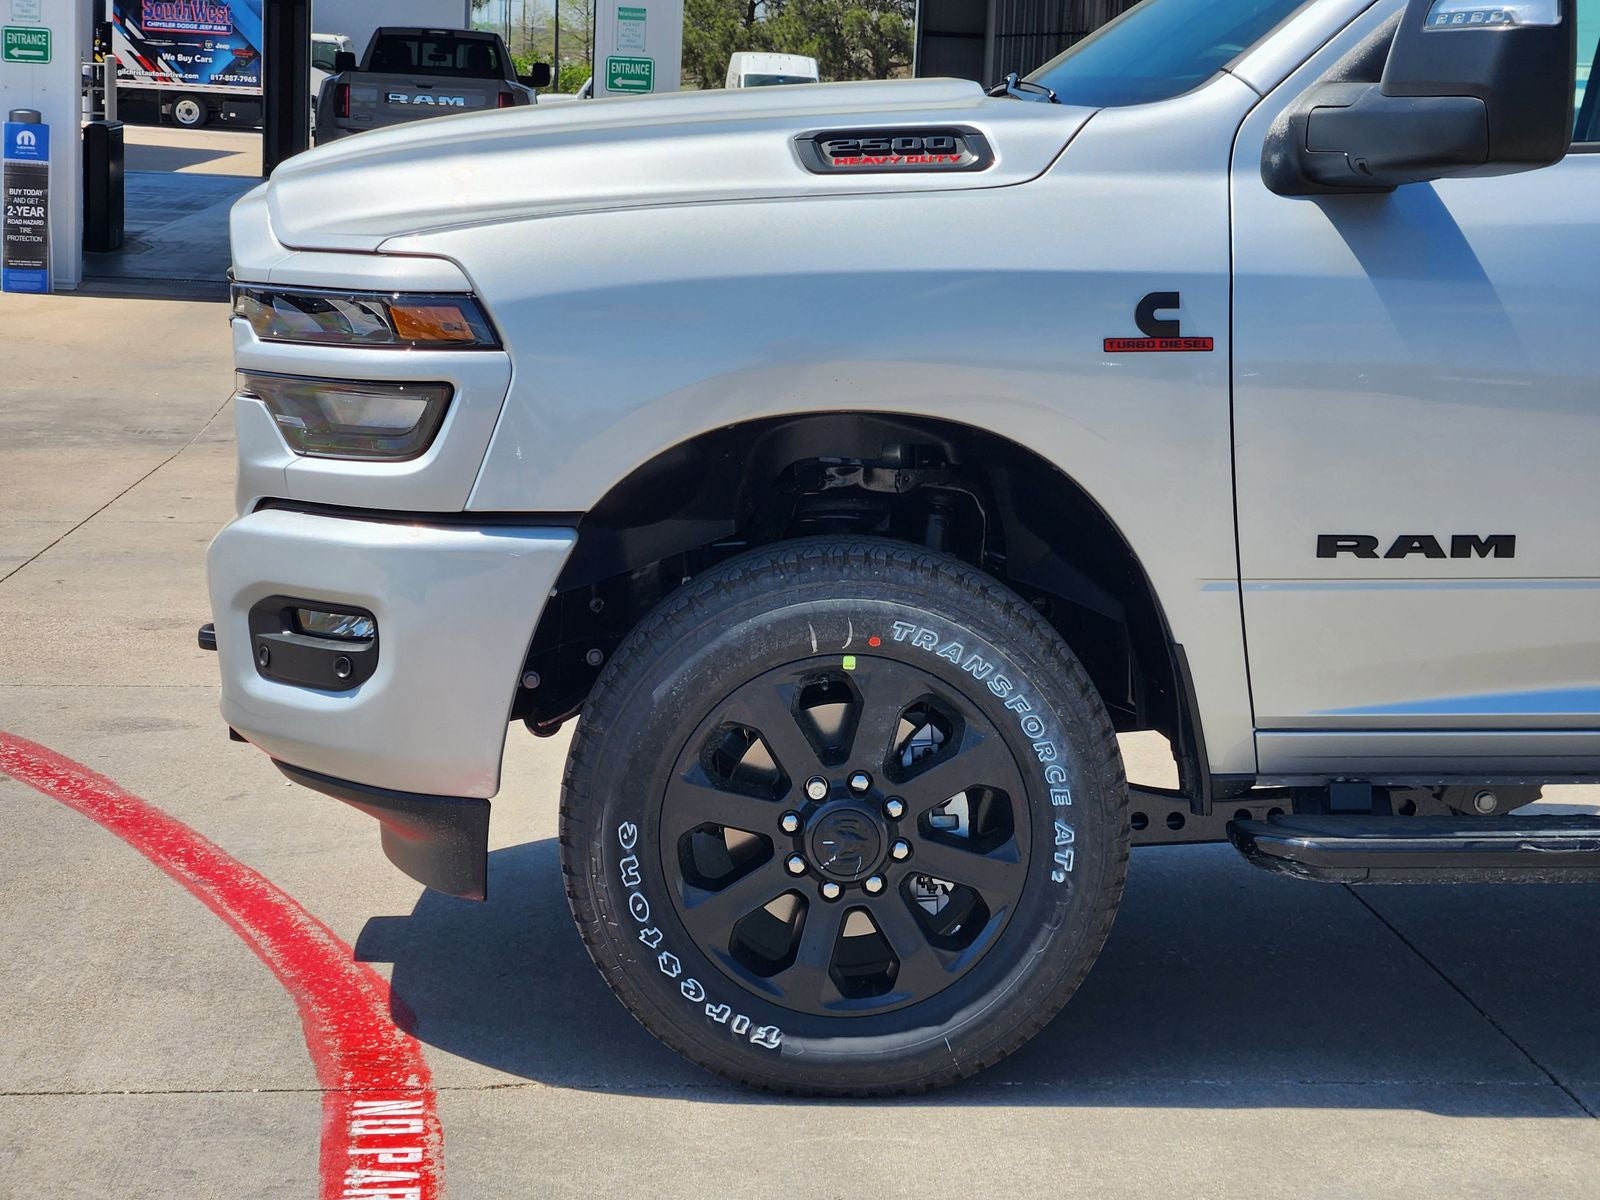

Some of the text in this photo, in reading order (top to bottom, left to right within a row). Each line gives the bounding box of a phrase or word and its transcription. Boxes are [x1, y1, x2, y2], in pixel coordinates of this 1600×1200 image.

[143, 0, 232, 23] SouthWest
[7, 33, 47, 45] ENTRANCE
[177, 54, 192, 63] Buy
[194, 55, 213, 63] Cars
[117, 69, 199, 79] gilchristautomotive.com
[611, 63, 650, 75] ENTRANCE
[210, 73, 257, 83] 817-887-7965
[387, 93, 465, 107] RAM
[829, 136, 957, 157] 2500
[833, 155, 961, 165] HEAVY DUTY
[9, 188, 22, 196] BUY
[26, 197, 39, 205] GET
[7, 205, 44, 217] 2-YEAR
[19, 226, 32, 234] TIRE
[7, 234, 43, 242] PROTECTION
[1108, 339, 1209, 350] TURBO DIESEL
[1316, 534, 1516, 559] RAM
[892, 620, 1072, 806] TRANSFORCE
[618, 821, 781, 1049] Firestone
[351, 1101, 424, 1135] NO
